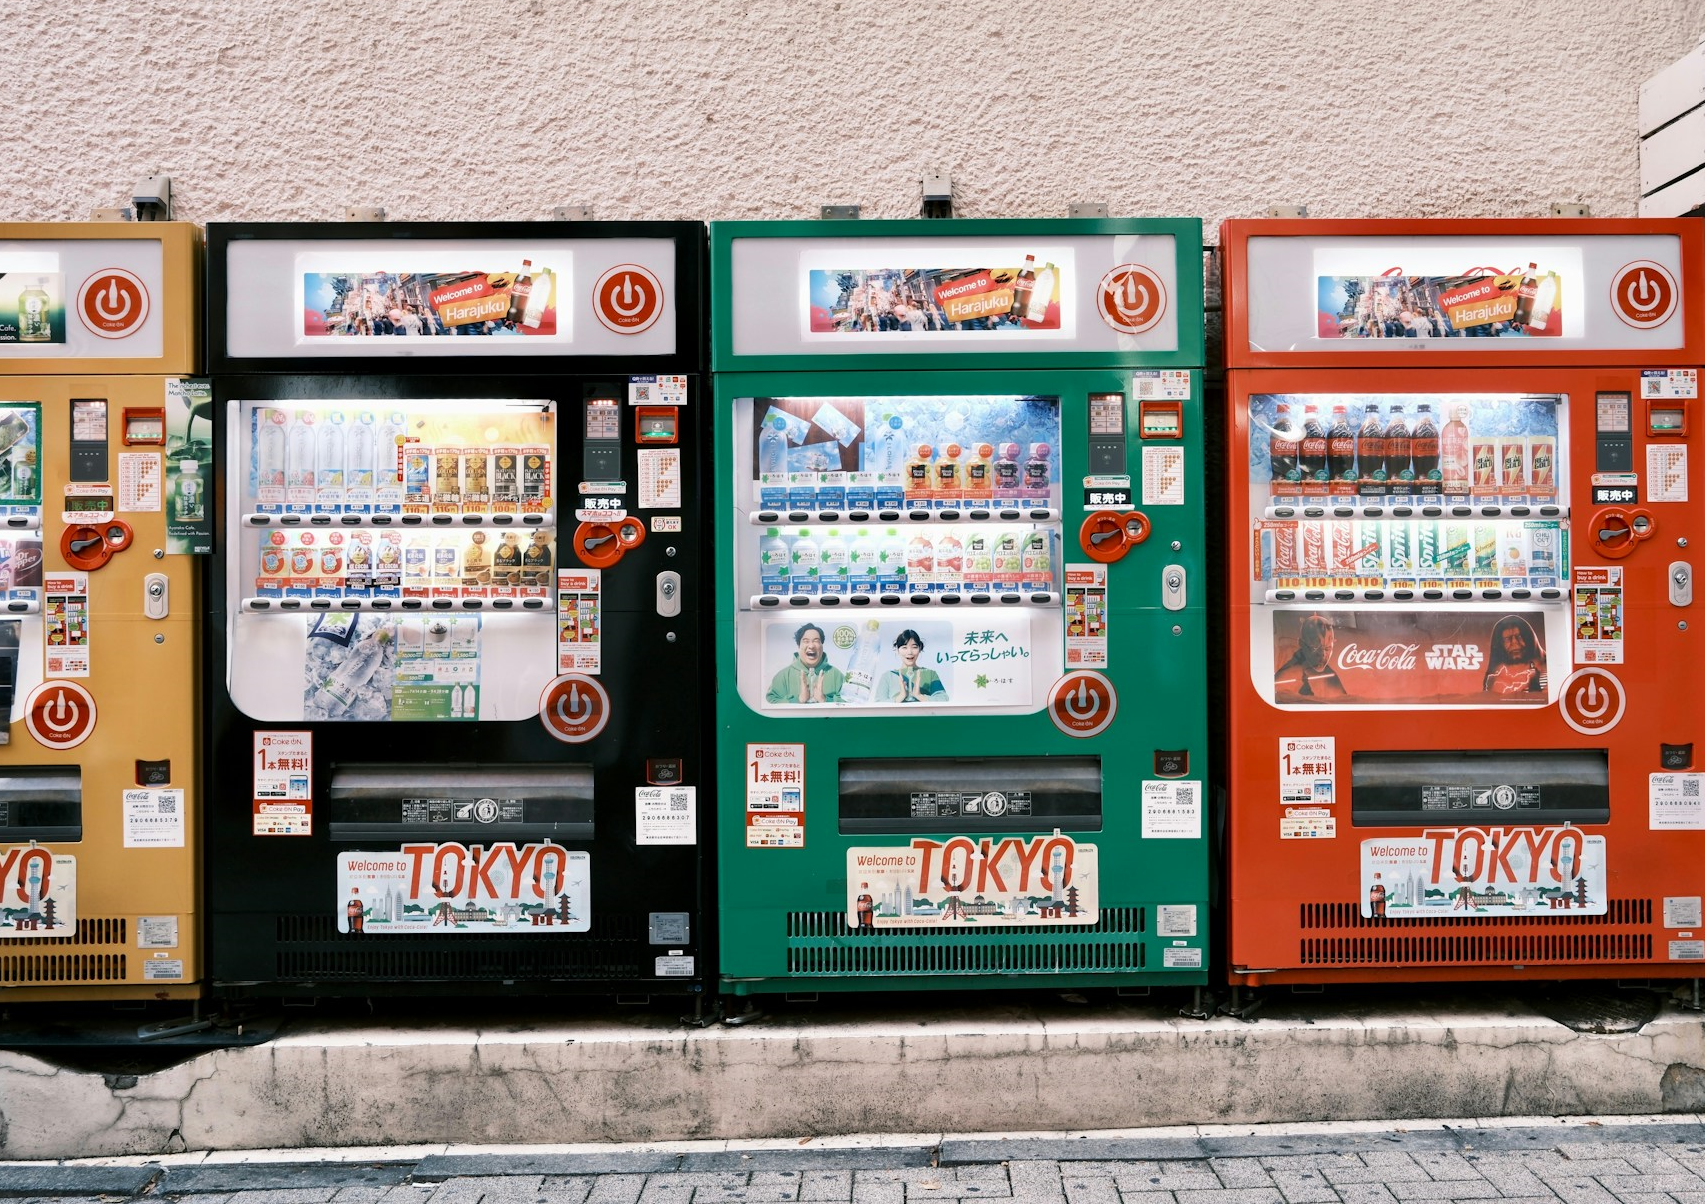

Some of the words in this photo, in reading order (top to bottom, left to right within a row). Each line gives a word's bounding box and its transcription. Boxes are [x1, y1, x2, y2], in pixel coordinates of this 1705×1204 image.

[434, 286, 472, 304] Welcome
[473, 283, 483, 292] to
[938, 282, 972, 300] Welcome
[974, 278, 986, 287] to
[1443, 290, 1478, 306] Welcome
[1480, 286, 1490, 294] to
[446, 302, 505, 320] Harajuku
[951, 296, 1008, 316] Harajuku
[1456, 302, 1511, 323] Harajuku
[1332, 440, 1353, 450] Coca-Cola
[584, 498, 621, 509] 販売中
[1090, 493, 1126, 504] 販売中
[1597, 490, 1633, 501] 販売中
[72, 500, 108, 510] 販売中
[18, 550, 29, 560] Dr
[964, 630, 1009, 645] 未来へ
[936, 646, 1030, 664] いってらっしゃい。
[1337, 643, 1420, 670] Coca-Cola
[1425, 644, 1484, 657] STAR
[1425, 656, 1482, 670] WARS
[258, 748, 308, 770] 1本無料!
[1283, 754, 1332, 775] 1本無料!
[750, 761, 800, 783] 1本無料!
[126, 792, 149, 800] Coca-Cola
[1370, 845, 1416, 856] Welcome
[1418, 845, 1428, 855] to
[1425, 829, 1583, 884] TOKYO
[348, 860, 395, 871] Welcome
[396, 861, 407, 871] to
[857, 855, 902, 866] Welcome
[905, 855, 916, 865] to
[912, 838, 1074, 894] TOKYO
[402, 844, 567, 899] TOKYO
